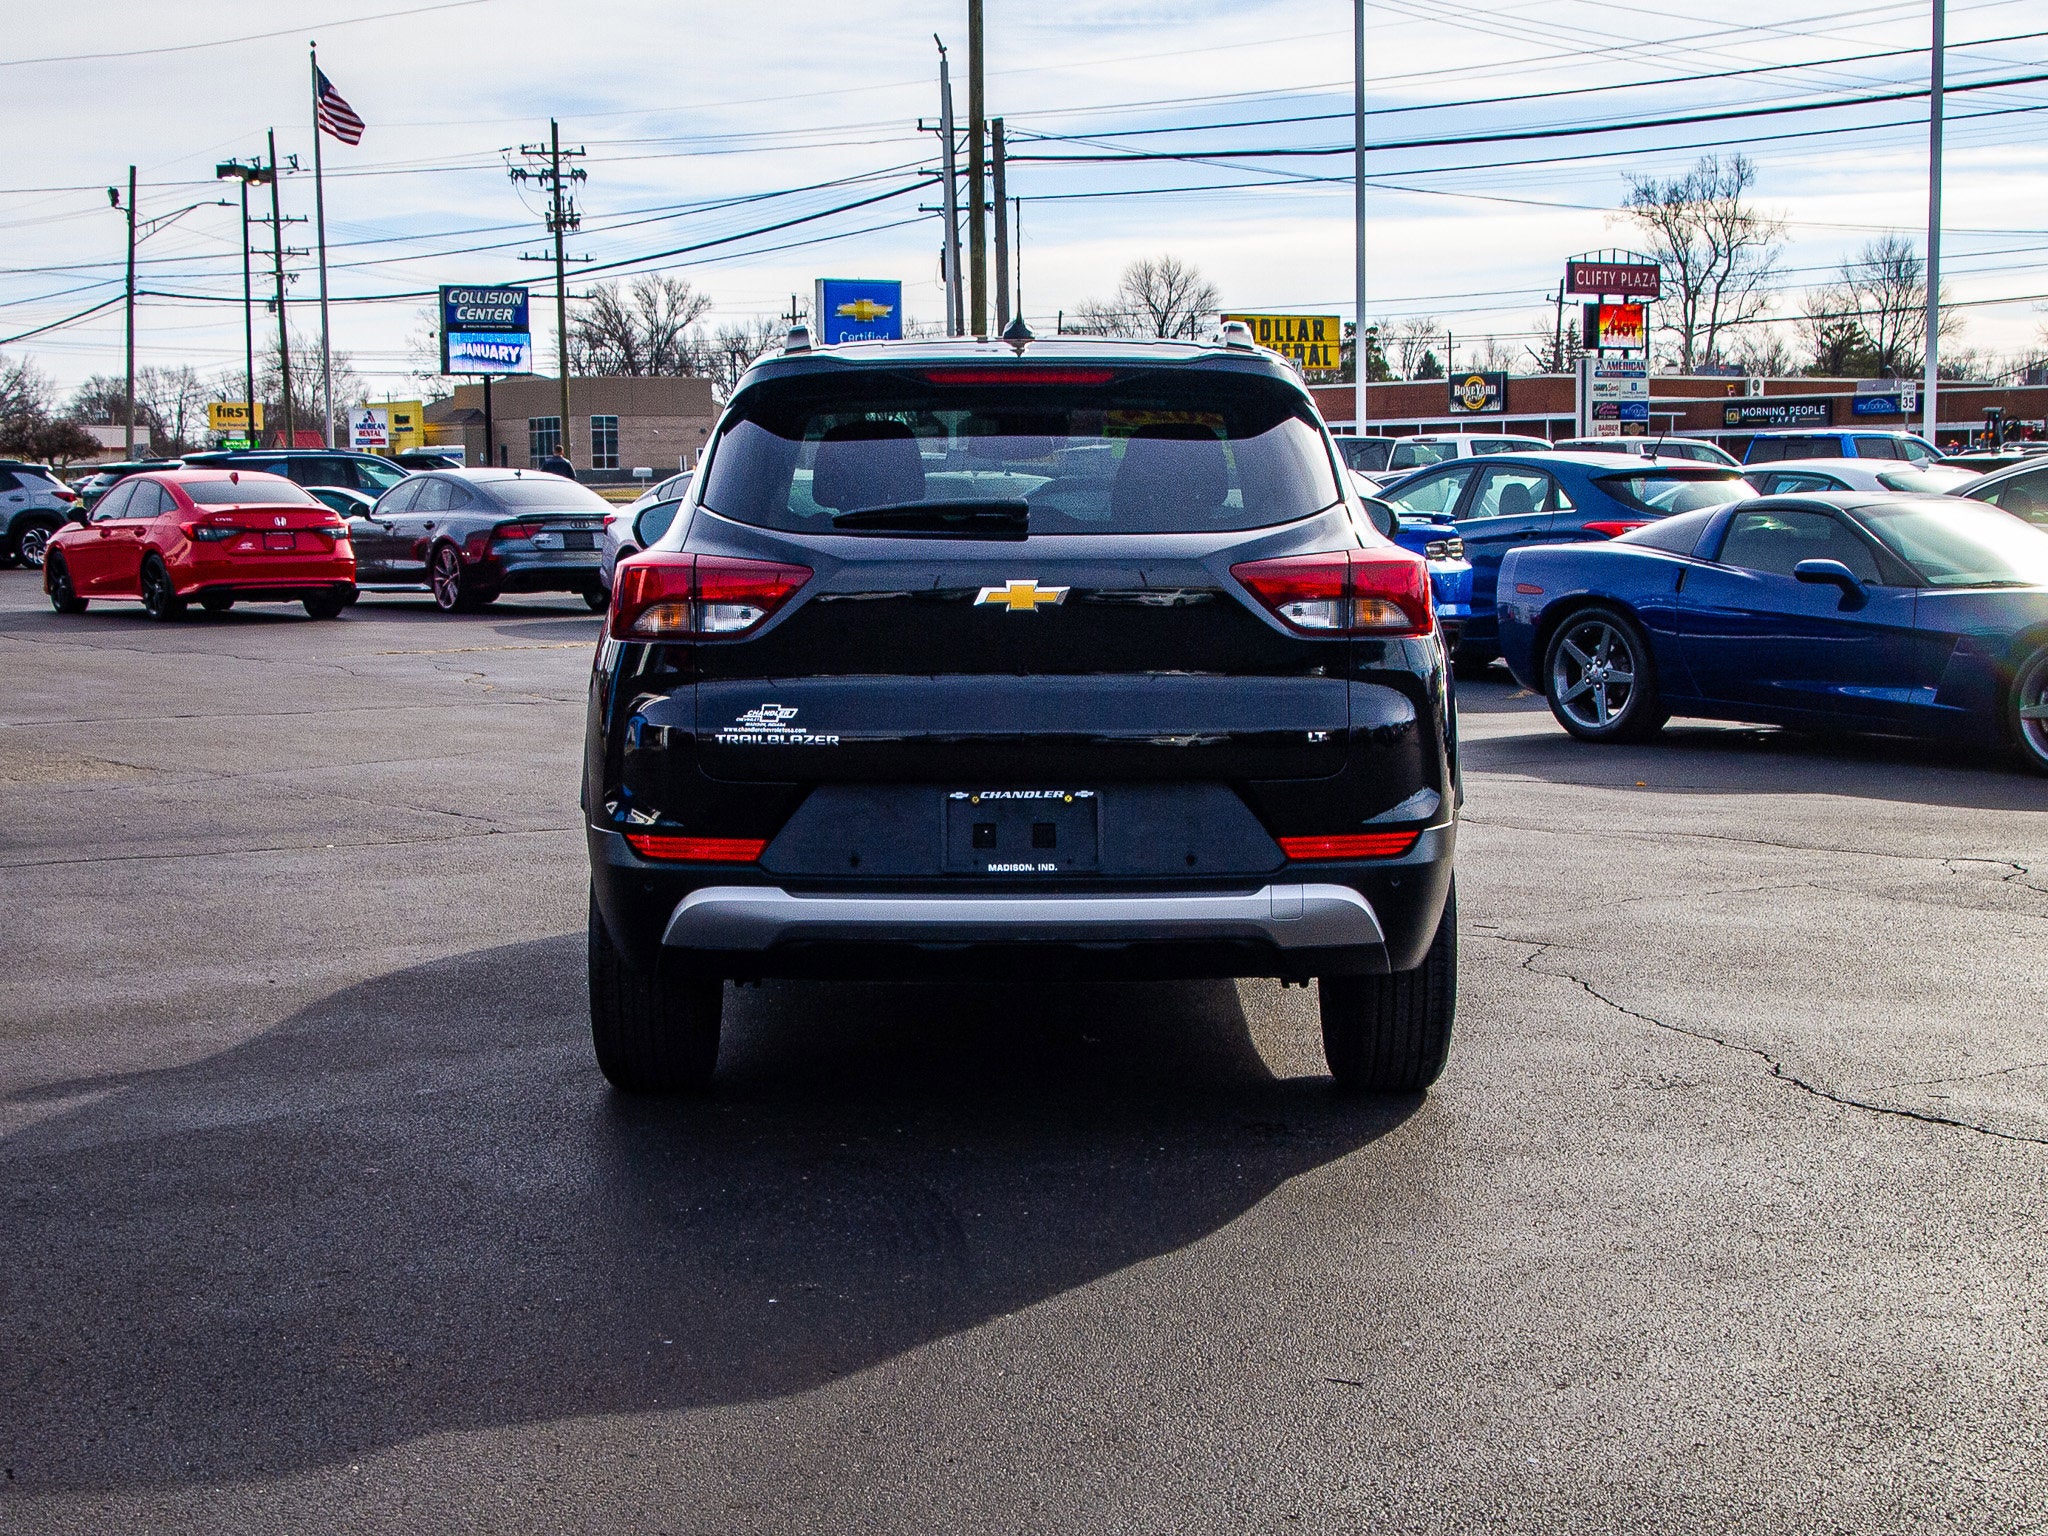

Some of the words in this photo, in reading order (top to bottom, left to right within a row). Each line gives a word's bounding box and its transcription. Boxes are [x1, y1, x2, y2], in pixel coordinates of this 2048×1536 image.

[1576, 270, 1616, 286] CLIFTY
[1621, 272, 1657, 288] PLAZA
[448, 290, 523, 304] COLLISION
[456, 306, 514, 321] CENTER
[461, 342, 520, 363] JANUARY
[1606, 361, 1646, 371] AMERICAN
[1902, 397, 1915, 409] 35
[1741, 407, 1786, 417] MORNING
[1789, 405, 1826, 415] PEOPLE
[1769, 416, 1797, 424] CAFE
[715, 734, 840, 746] TRAILBLAZER
[1308, 731, 1327, 742] LT
[980, 790, 1065, 799] CHANDLER
